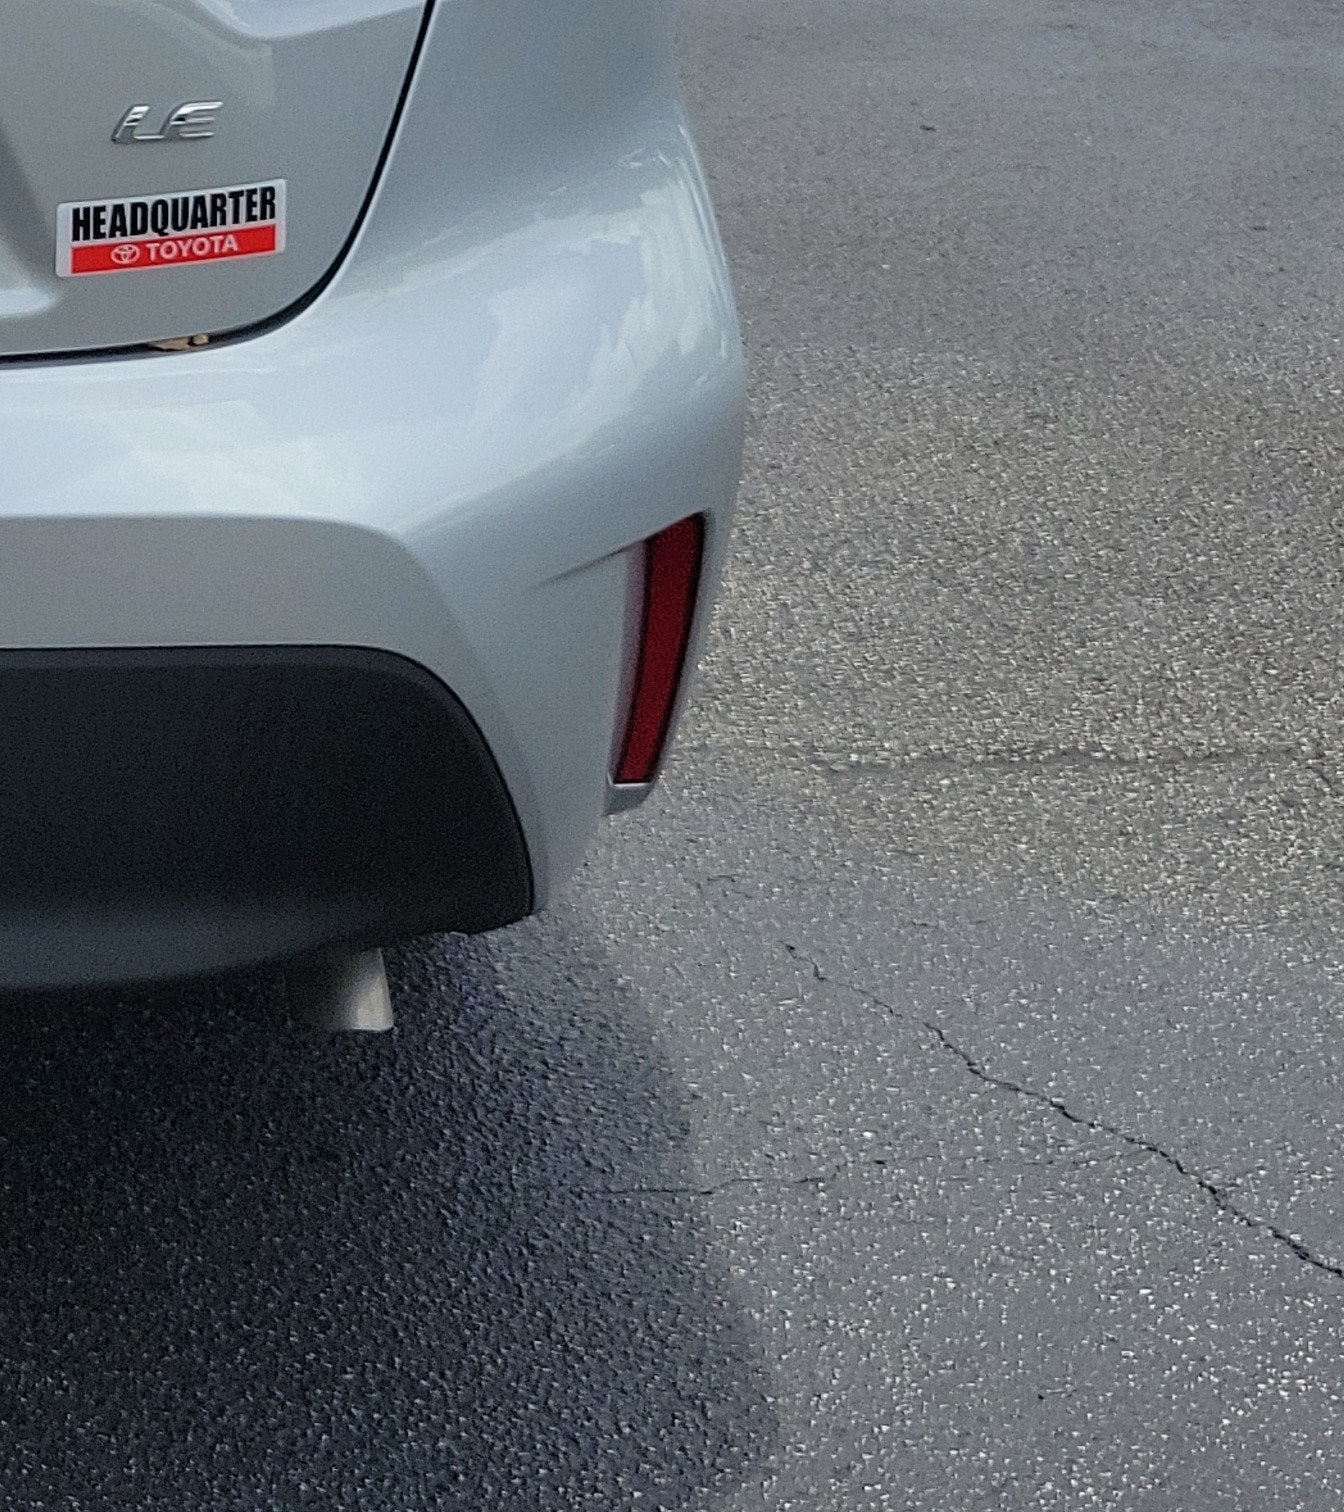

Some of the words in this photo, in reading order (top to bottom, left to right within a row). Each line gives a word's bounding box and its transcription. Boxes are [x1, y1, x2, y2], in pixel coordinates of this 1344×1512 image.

[111, 100, 224, 145] LE
[71, 185, 276, 242] HEADQUARTER
[146, 234, 239, 262] TOYOTA
